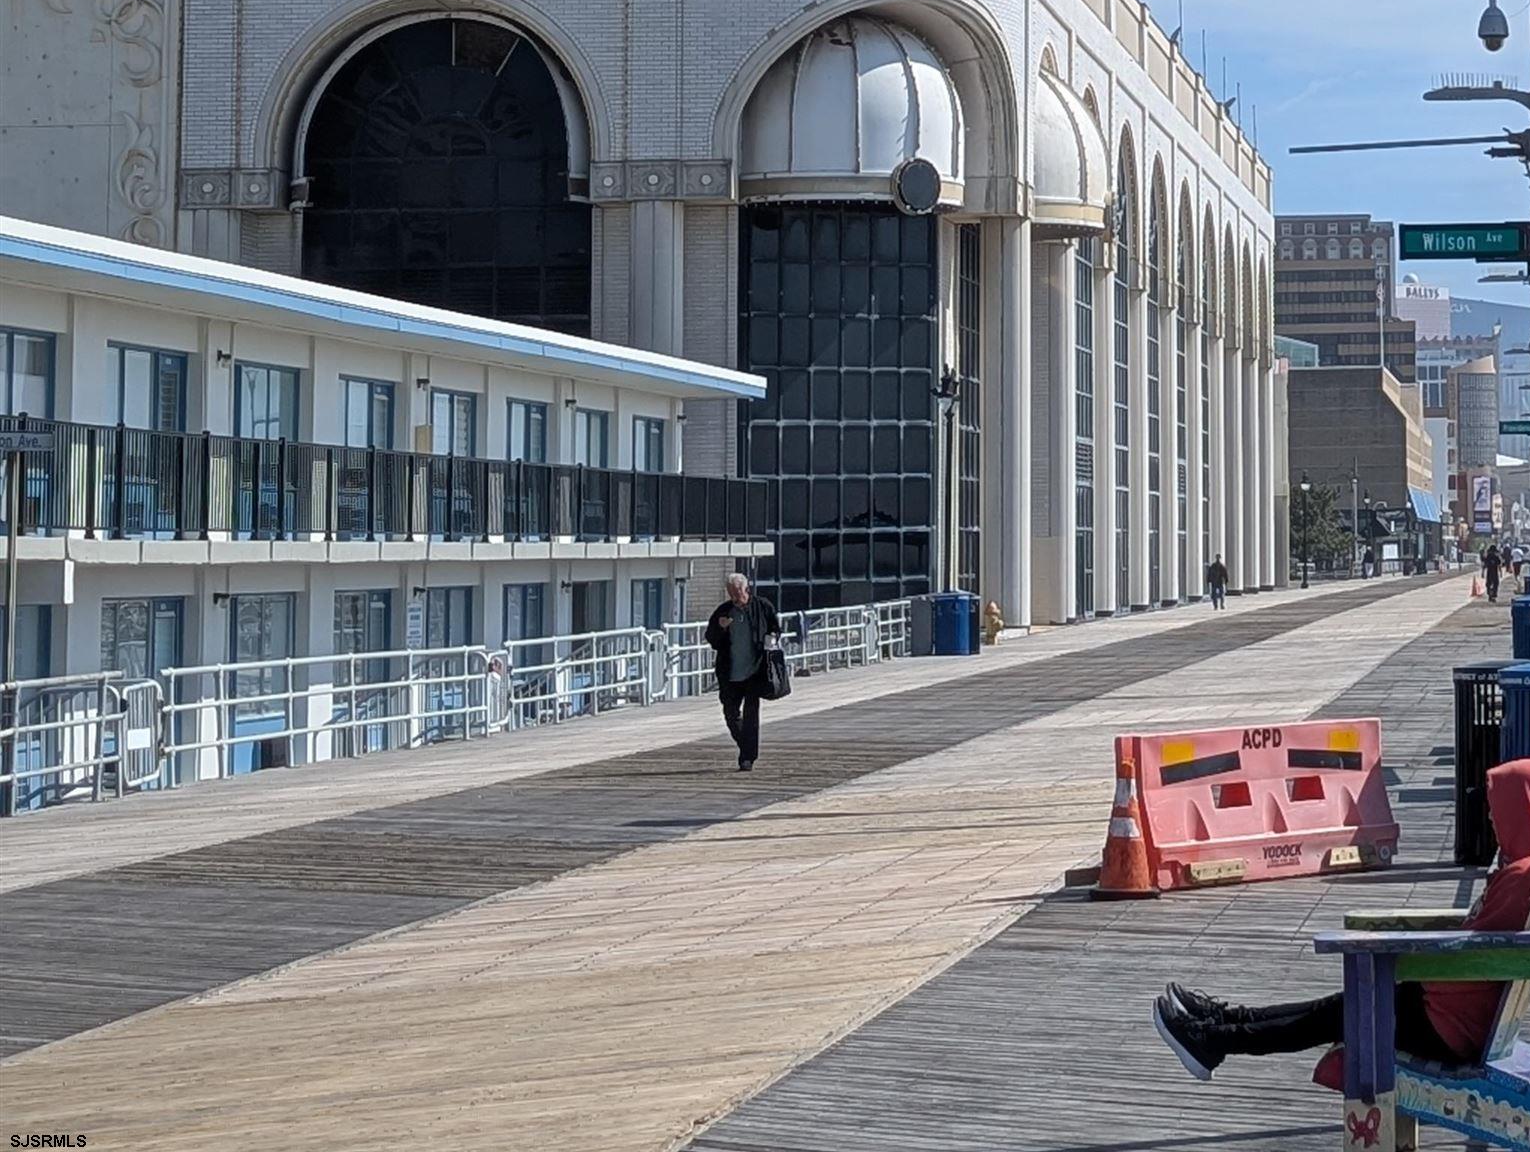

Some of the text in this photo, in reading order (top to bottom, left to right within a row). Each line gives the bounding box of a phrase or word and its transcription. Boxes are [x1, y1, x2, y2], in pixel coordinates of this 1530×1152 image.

[1422, 232, 1503, 251] Wilson Ave
[1242, 727, 1283, 750] ACPD
